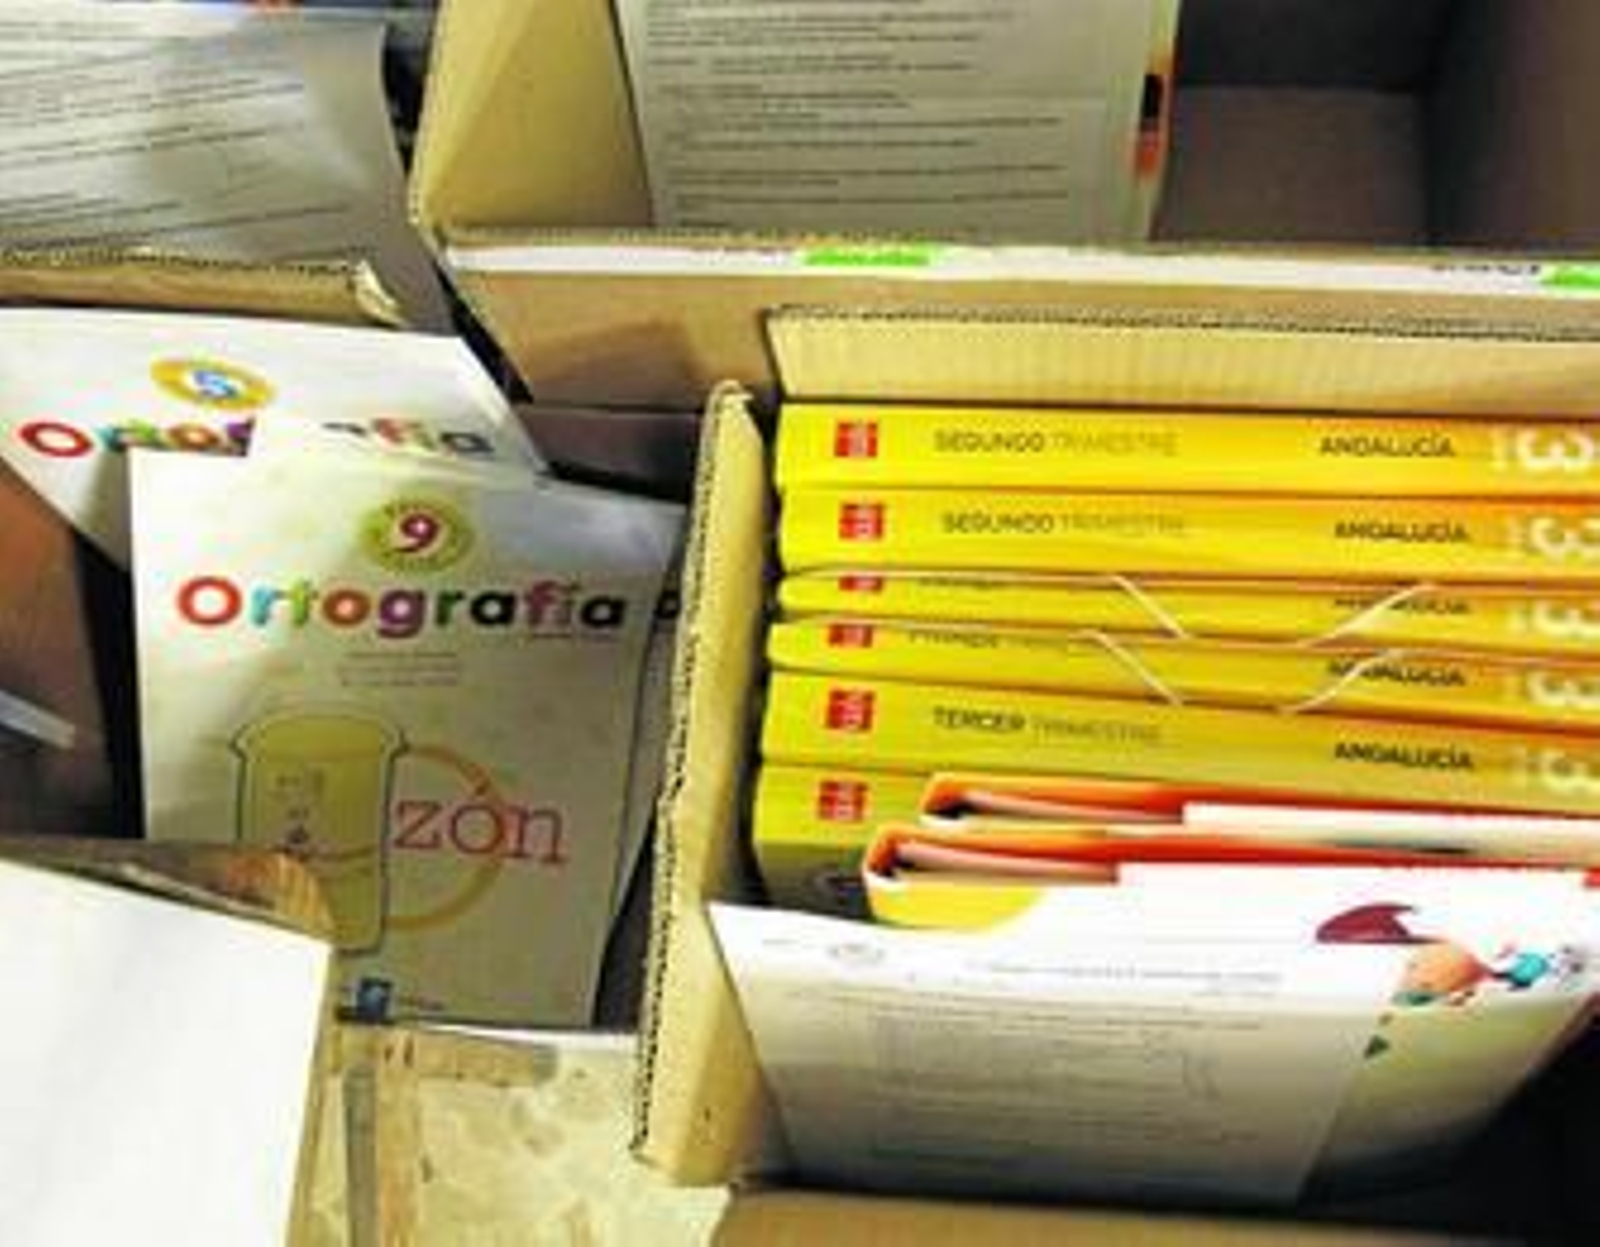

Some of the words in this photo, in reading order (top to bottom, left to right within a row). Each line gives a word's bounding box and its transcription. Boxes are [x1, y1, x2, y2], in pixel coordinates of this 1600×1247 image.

[934, 431, 1046, 453] SEGUNDO
[1320, 436, 1455, 457] ANDALUCÍA
[399, 513, 438, 551] 9
[942, 512, 1054, 534] SEGUNDO
[1334, 520, 1470, 543] ANDALUCÍA
[177, 574, 625, 638] Ortografía
[934, 707, 1024, 732] TERCER
[1334, 742, 1474, 770] ANDALUCÍA
